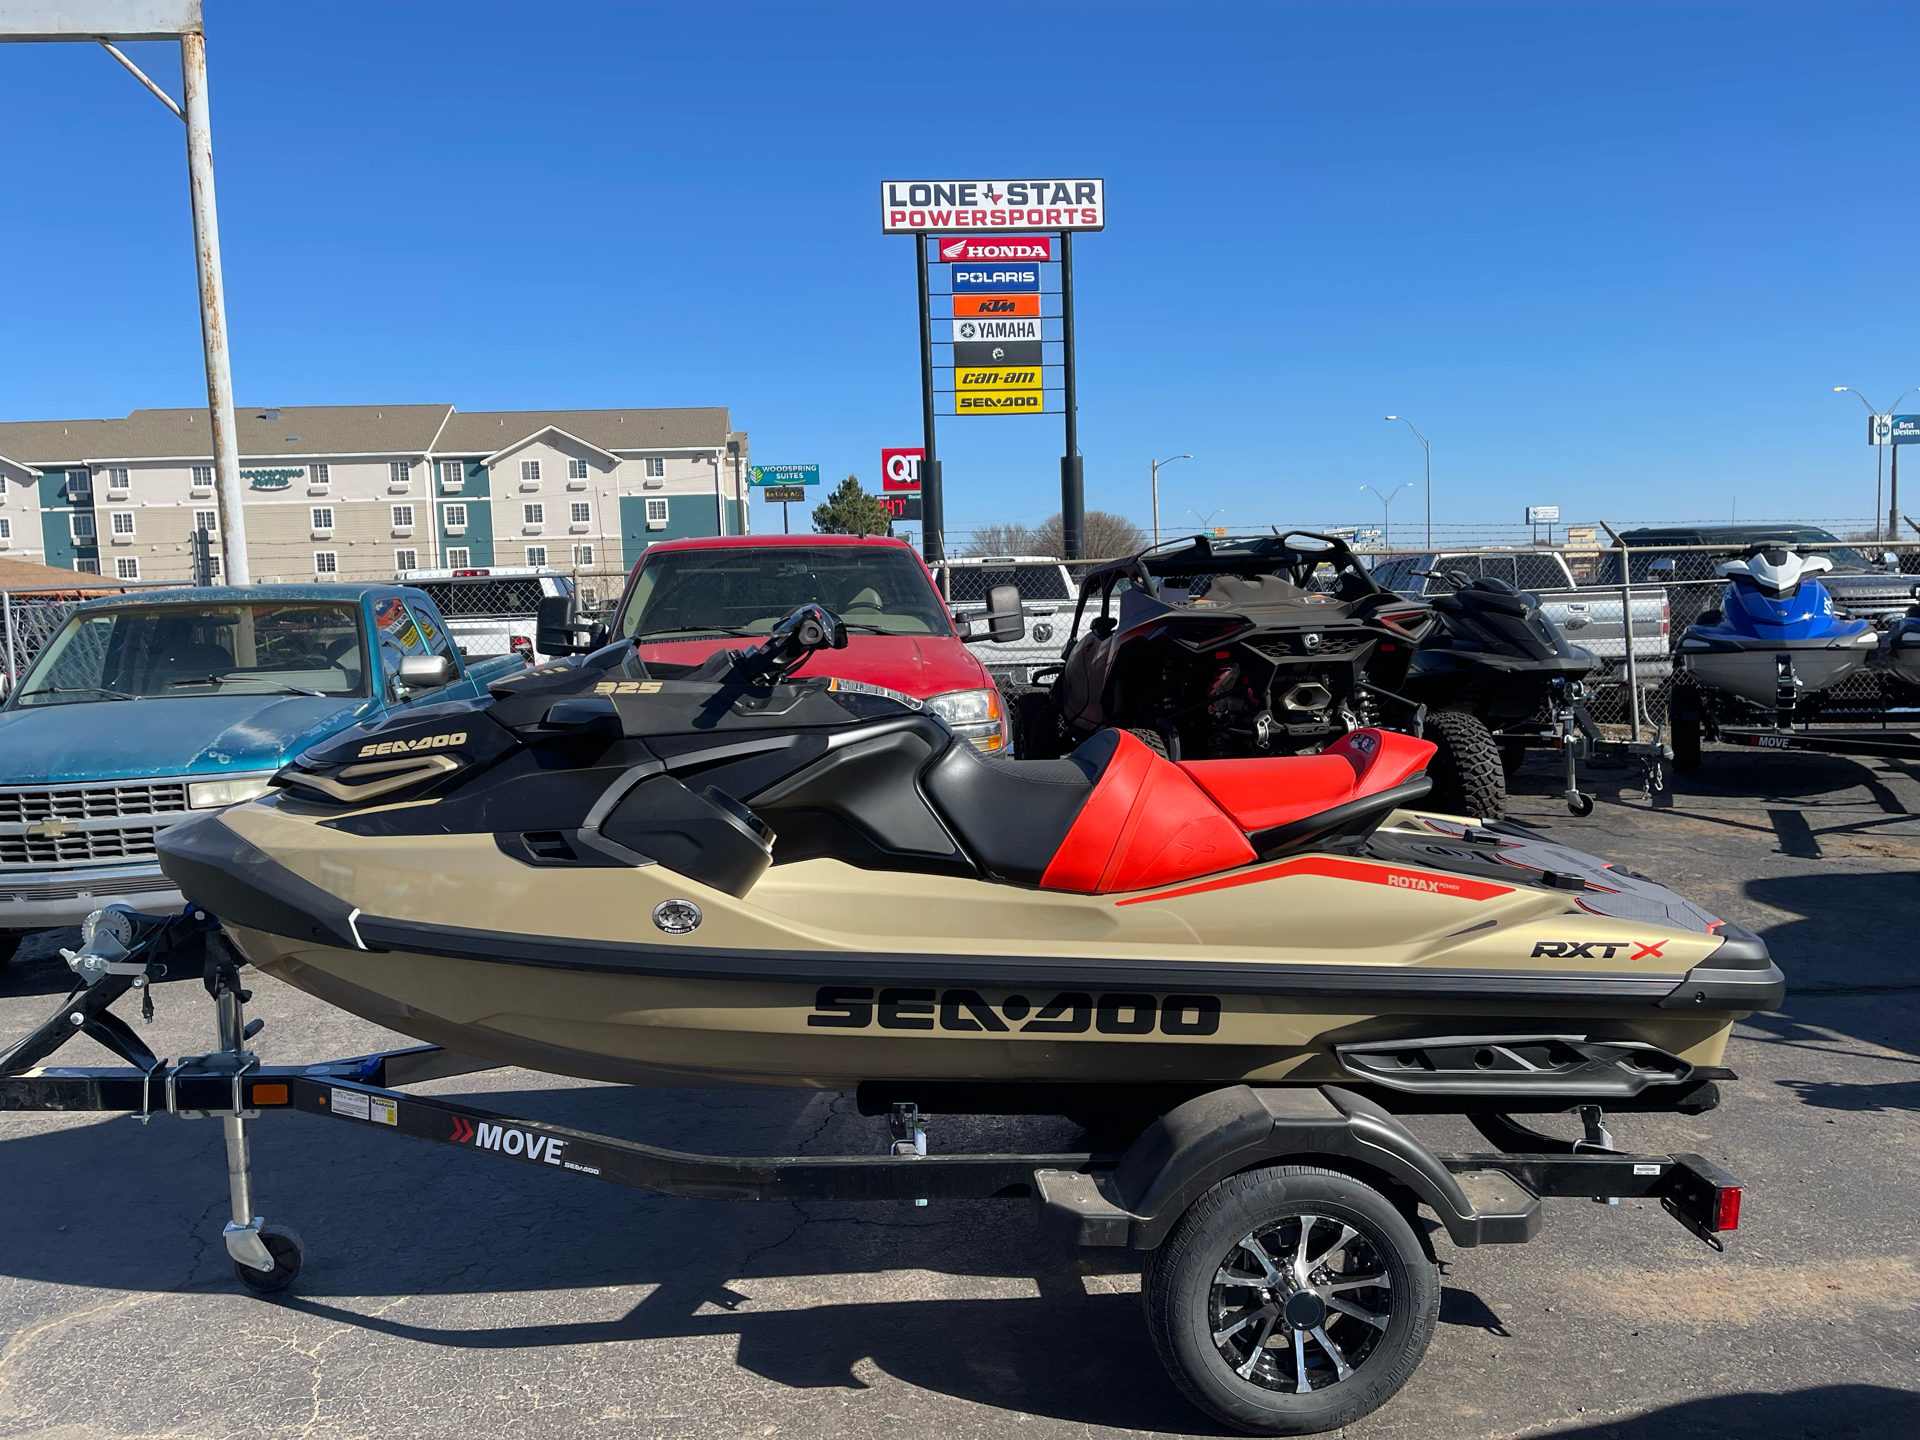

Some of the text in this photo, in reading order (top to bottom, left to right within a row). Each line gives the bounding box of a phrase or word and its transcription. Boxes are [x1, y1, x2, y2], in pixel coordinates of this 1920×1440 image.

[889, 182, 1096, 206] LONE STAR
[890, 208, 1097, 226] POWERSPORTS
[967, 246, 1048, 258] HONDA
[956, 271, 1035, 282] POLARIS
[978, 299, 1016, 312] KTM
[978, 322, 1035, 338] YAMAHA
[962, 372, 1035, 384] can-am
[1893, 428, 1920, 436] Western
[887, 454, 921, 482] QT
[1823, 596, 1833, 616] VX
[594, 681, 664, 694] 325
[1758, 737, 1790, 748] MOVE
[1388, 874, 1460, 893] ROTAX POWER
[1530, 939, 1669, 960] RXT X
[475, 1122, 566, 1166] MOVE
